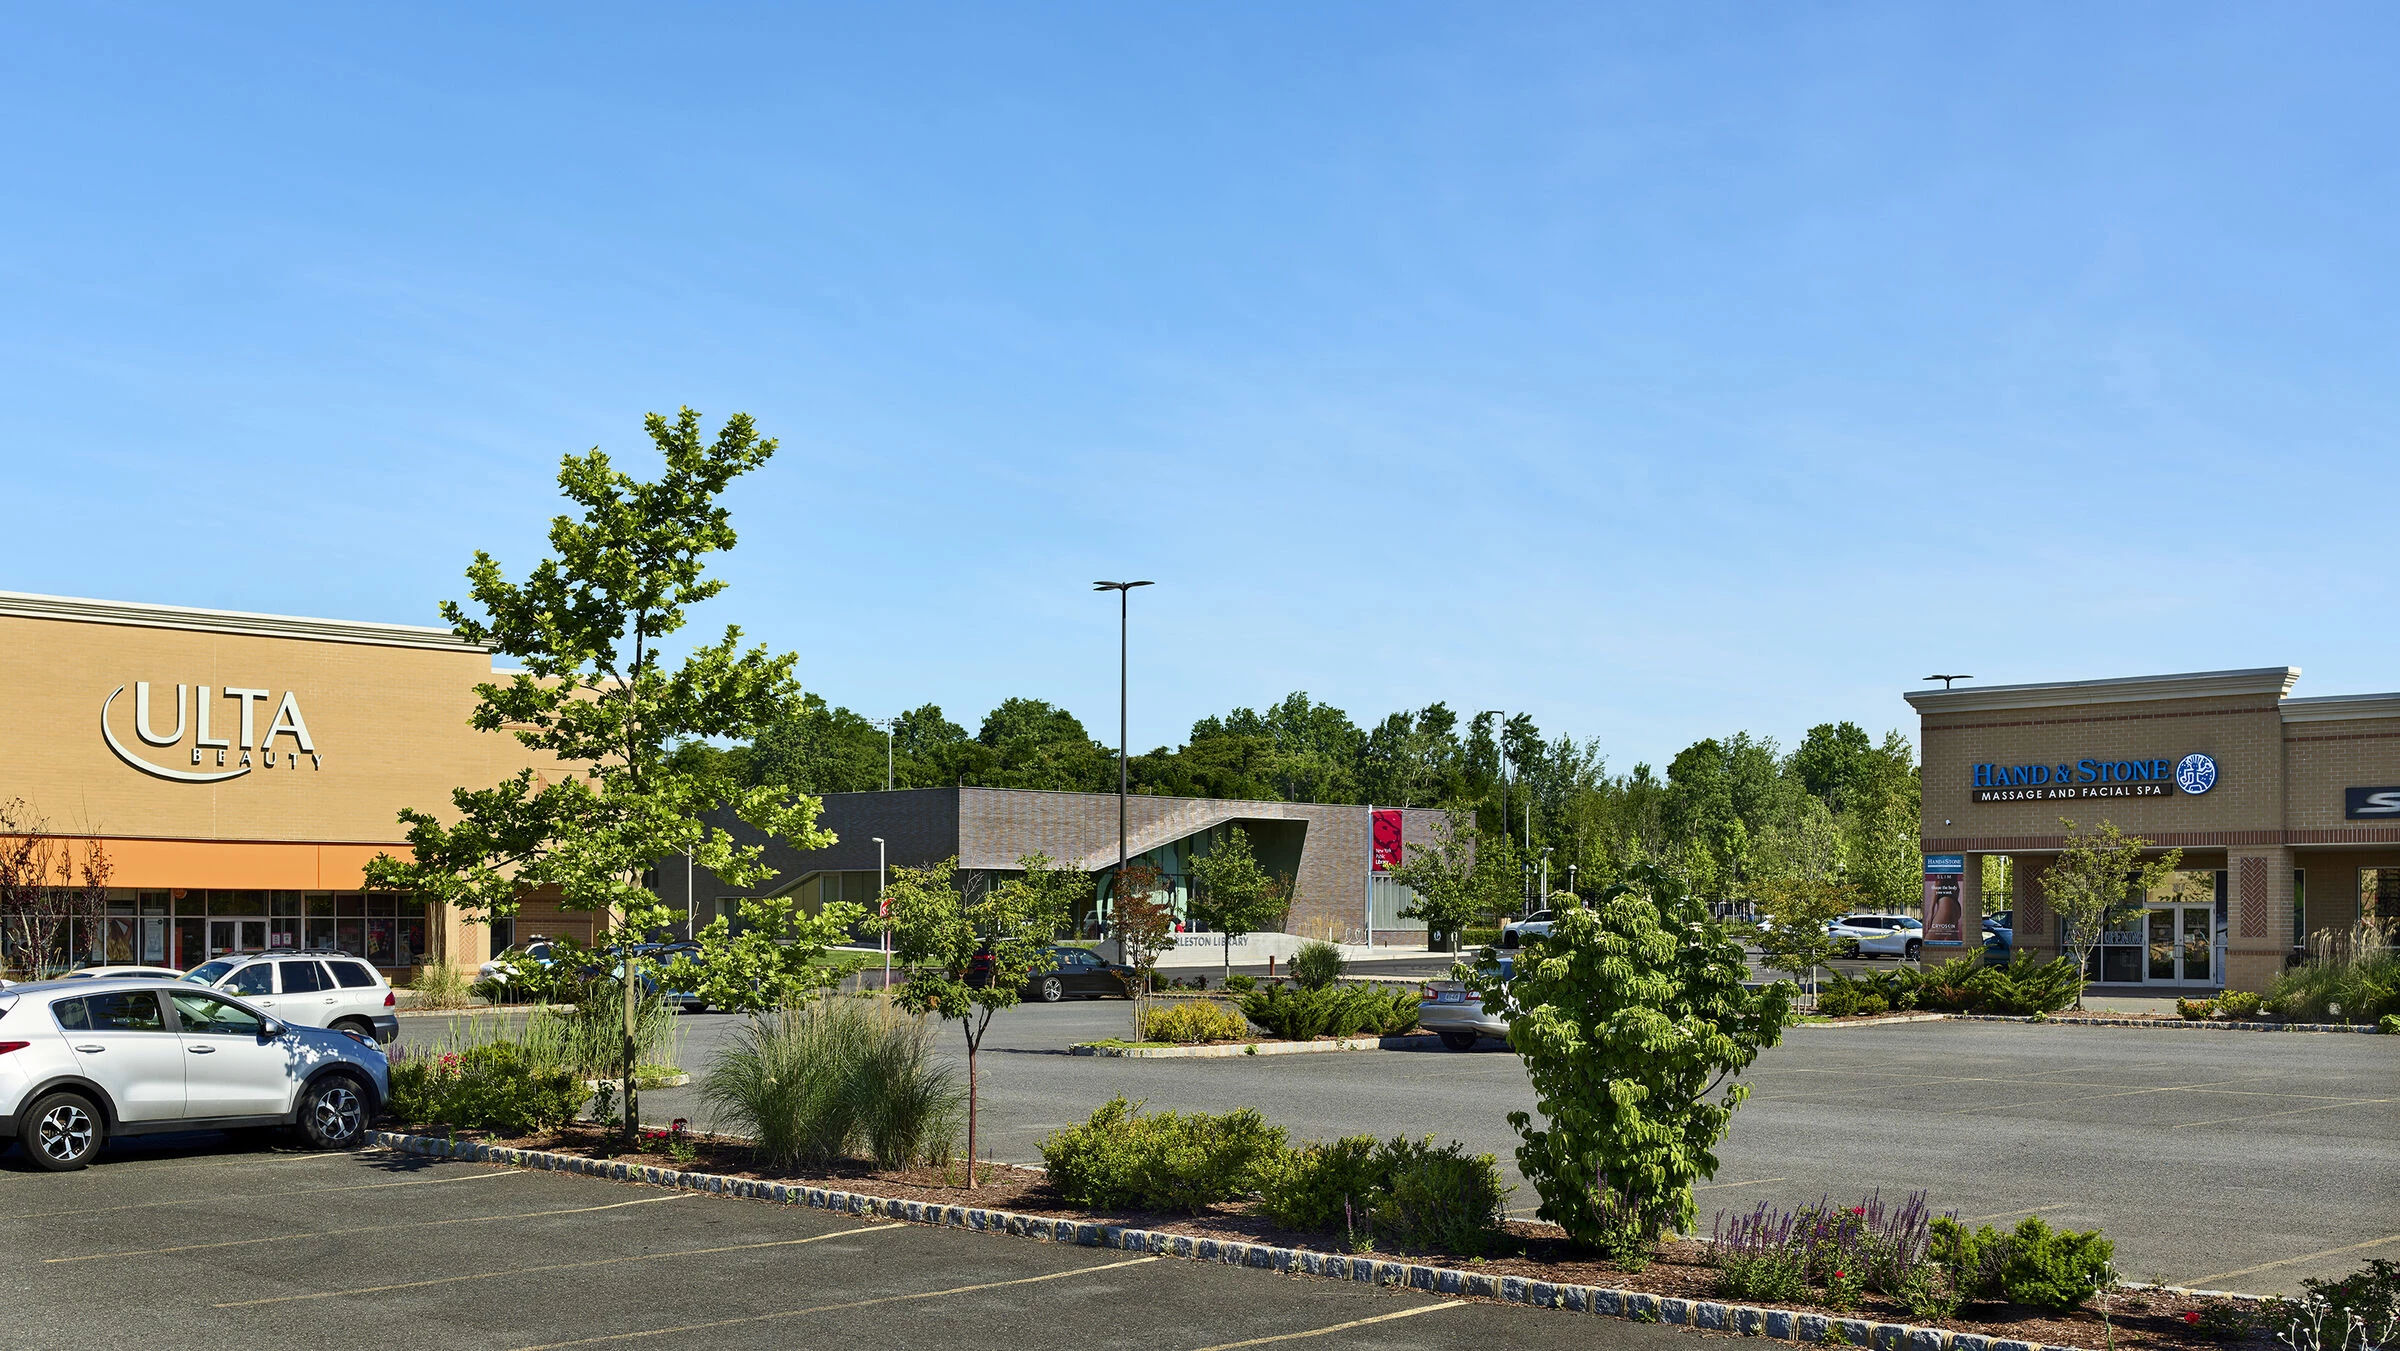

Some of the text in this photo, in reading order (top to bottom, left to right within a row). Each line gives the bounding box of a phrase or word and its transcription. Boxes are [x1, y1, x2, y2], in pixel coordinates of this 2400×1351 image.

[135, 681, 314, 753] ULTA
[190, 748, 324, 770] BEAUTY
[1972, 758, 2171, 787] HAND & STONE
[1981, 785, 2162, 801] MASSAGE AND FACIAL SPA
